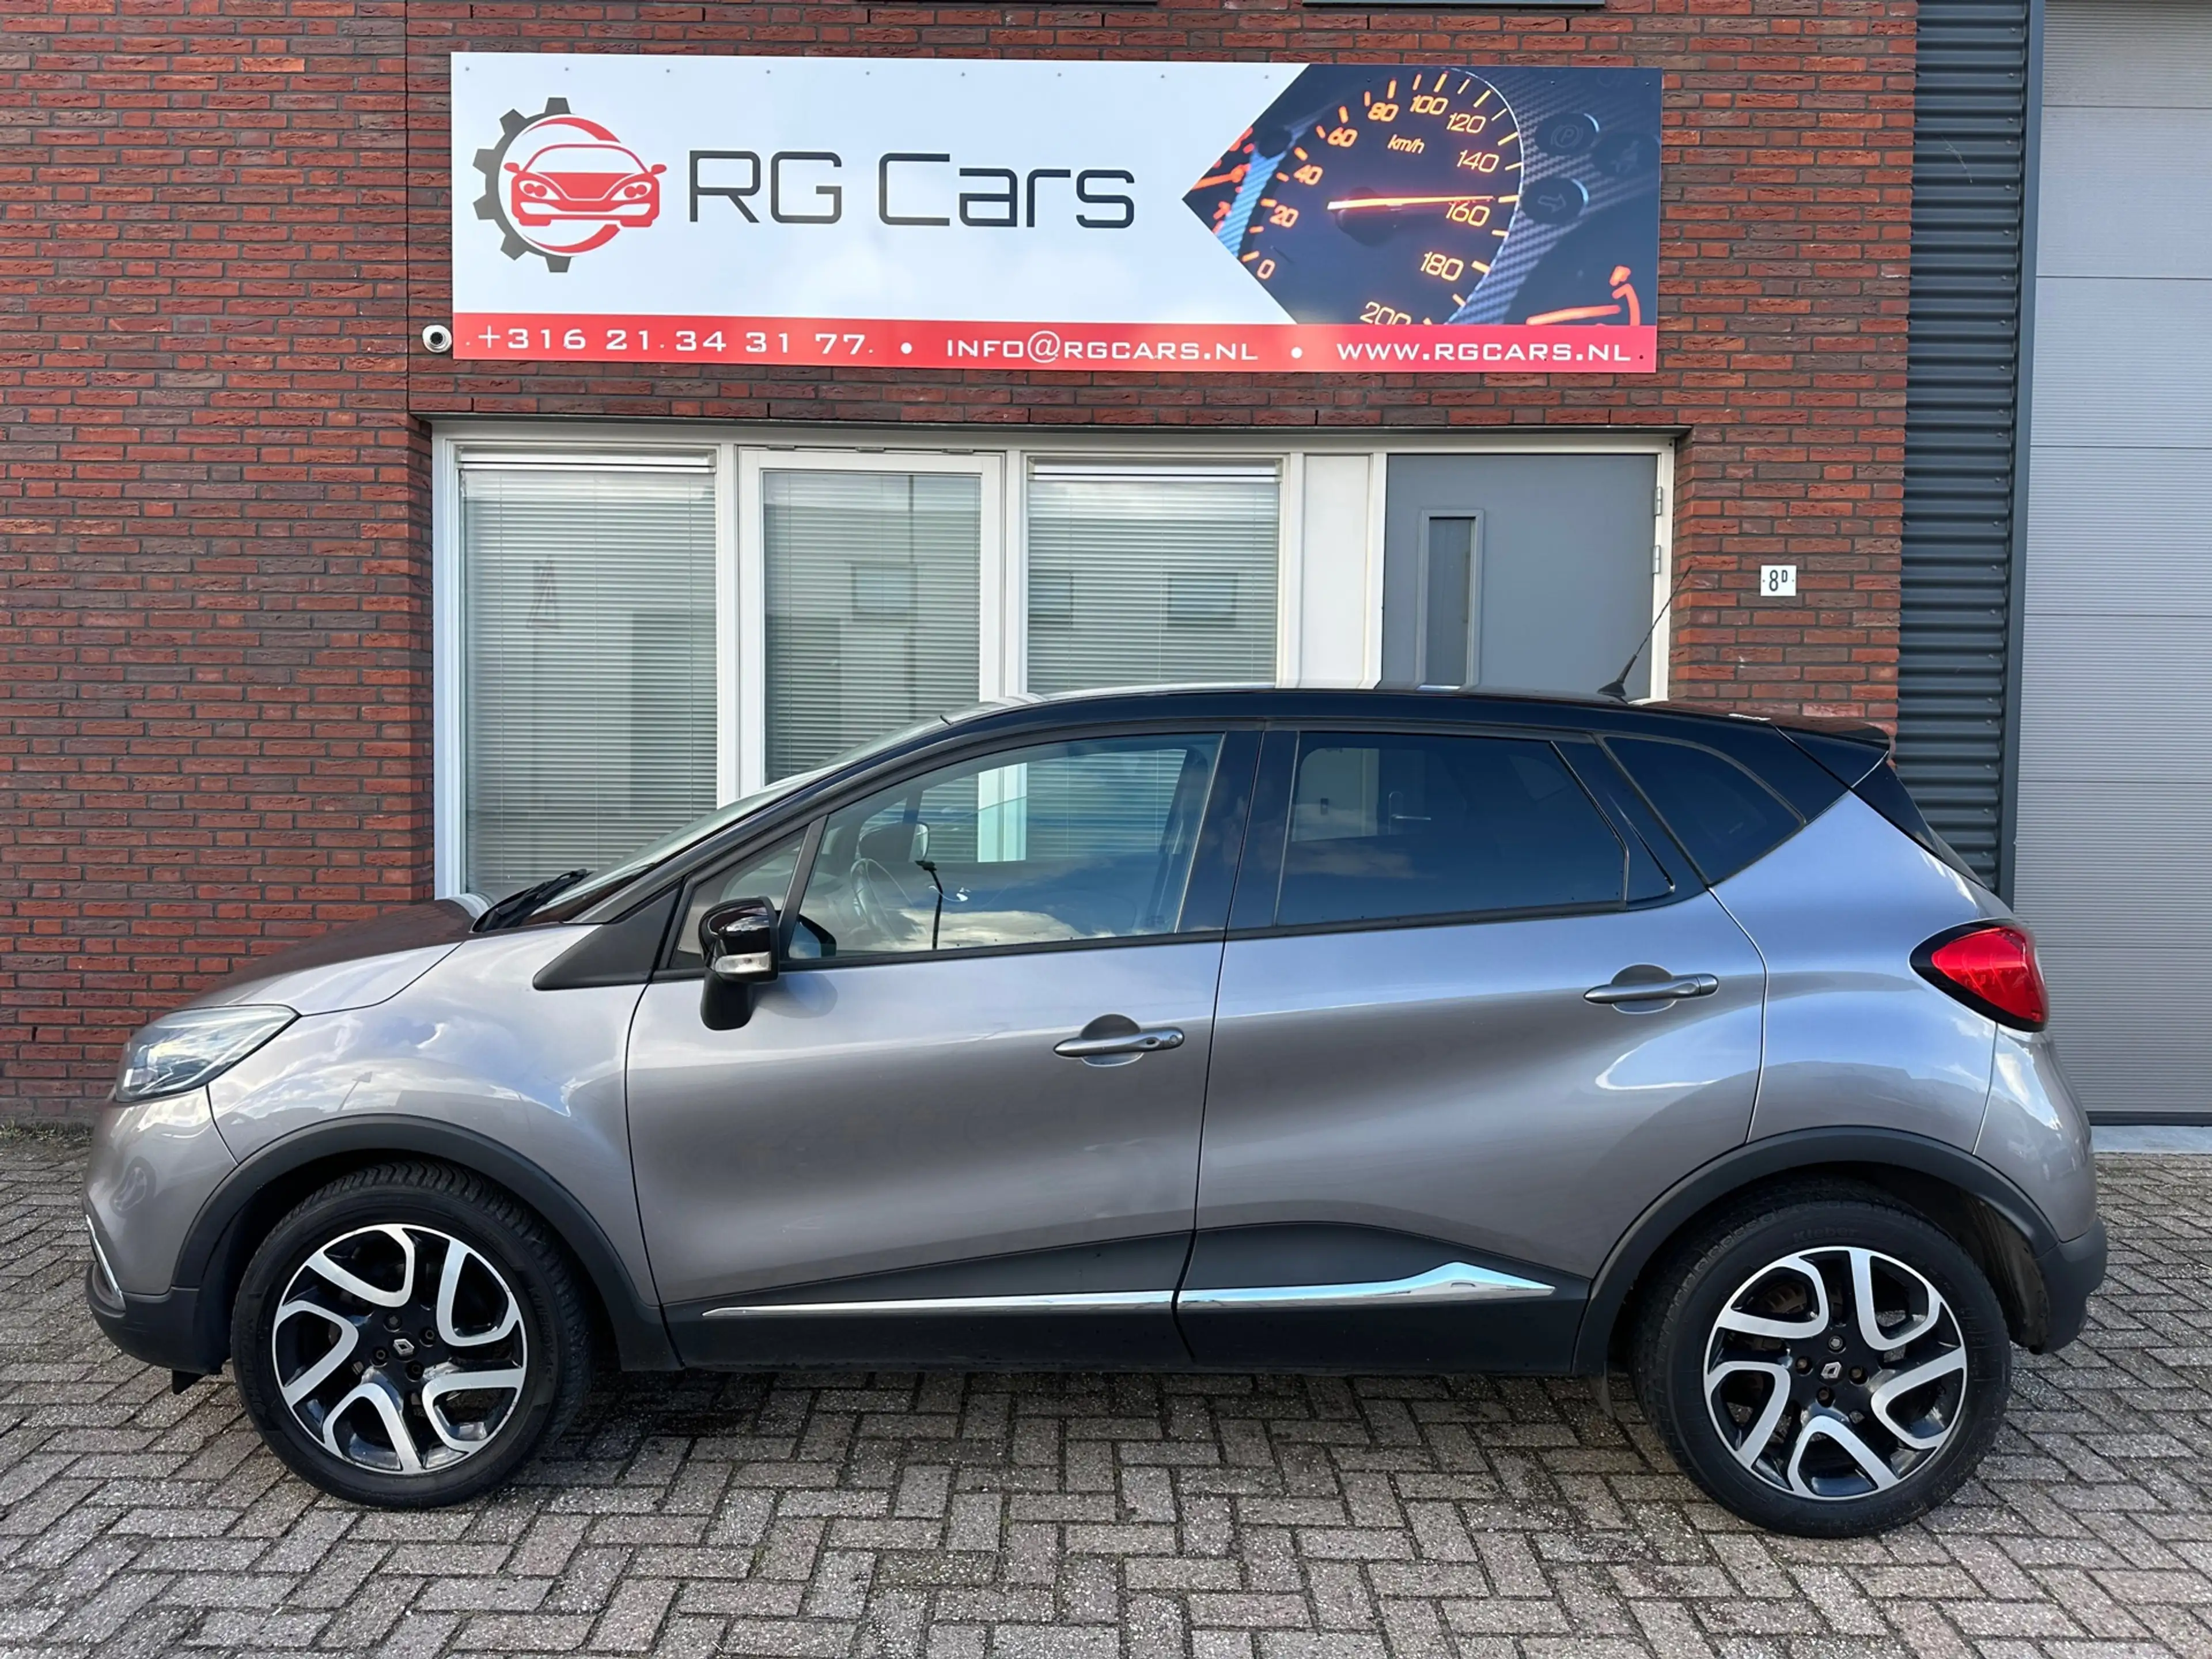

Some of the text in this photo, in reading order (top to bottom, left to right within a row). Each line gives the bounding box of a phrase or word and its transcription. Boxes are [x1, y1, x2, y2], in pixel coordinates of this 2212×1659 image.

[1368, 101, 1399, 122] 80
[1410, 94, 1449, 115] 100
[1446, 112, 1487, 134] 120
[1327, 126, 1358, 147] 60
[1387, 134, 1425, 154] km/h
[1457, 150, 1499, 173] 140
[1293, 164, 1324, 185] 40
[689, 150, 1135, 229] RG Cars
[1270, 204, 1299, 228] 20
[1446, 202, 1490, 227] 160
[1257, 259, 1275, 279] 0
[1420, 251, 1464, 281] 180
[478, 325, 1631, 363] +316 21 34 31 77 INFO@RGCARS.NL WWW.RGCARS.NL
[1793, 1226, 1859, 1244] Kleber
